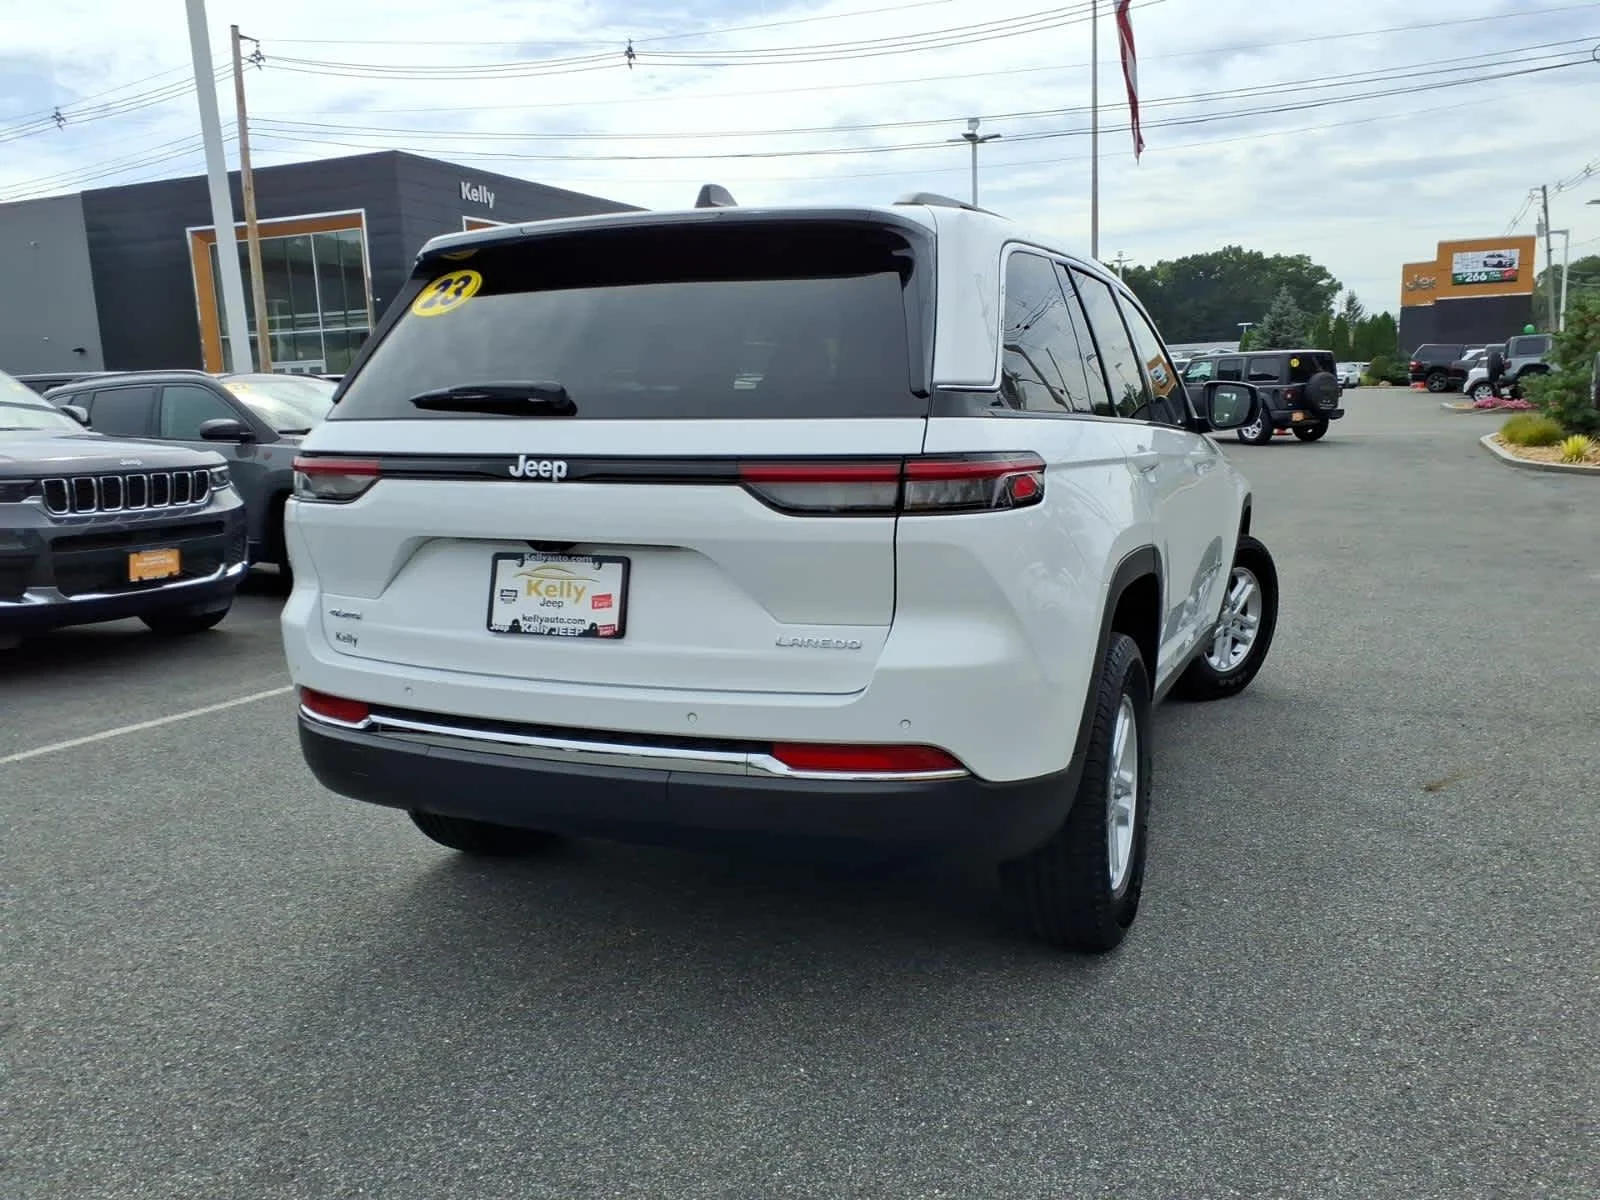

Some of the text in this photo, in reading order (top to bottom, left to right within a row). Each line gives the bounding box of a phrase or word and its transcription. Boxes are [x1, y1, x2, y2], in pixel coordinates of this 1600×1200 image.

[460, 181, 495, 209] Kelly
[421, 275, 472, 308] 23
[508, 454, 568, 483] Jeep
[526, 579, 586, 604] Kelly
[539, 598, 564, 609] Jeep
[521, 614, 586, 626] kellyauto.com
[521, 623, 551, 635] Kelly
[551, 626, 585, 637] JEEP
[775, 637, 863, 649] LAREDO
